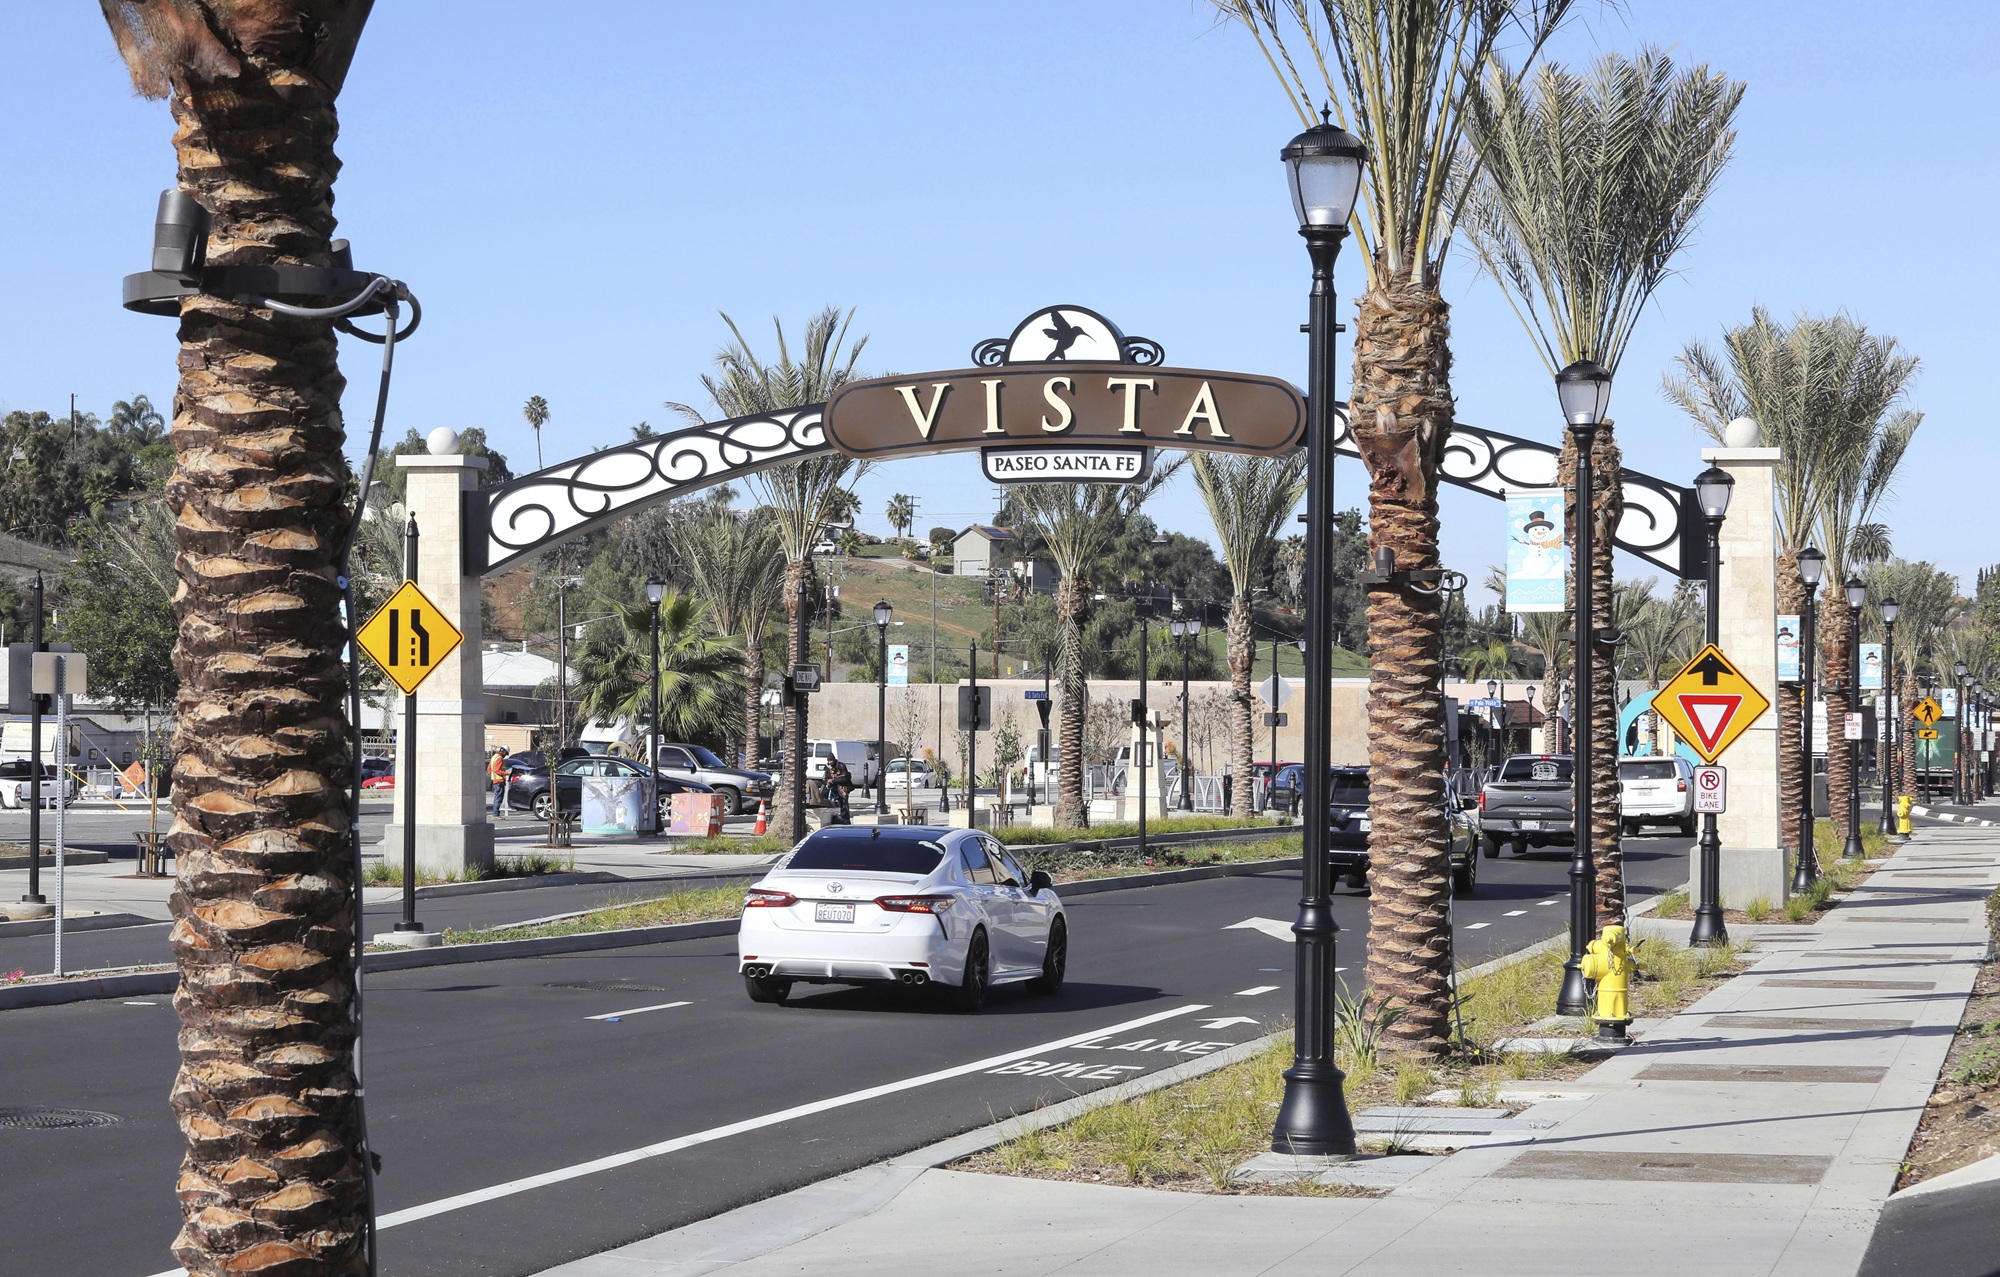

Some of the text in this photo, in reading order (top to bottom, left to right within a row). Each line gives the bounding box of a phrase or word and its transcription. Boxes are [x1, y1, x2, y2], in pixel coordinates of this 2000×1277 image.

[894, 376, 1231, 439] VISTA
[994, 455, 1135, 471] PASEO SANTA FE
[1700, 792, 1718, 800] BIKE
[1699, 801, 1719, 809] LANE
[818, 909, 852, 921] 8EUT070
[1069, 1036, 1237, 1055] LANE
[983, 1060, 1146, 1080] BIKE
